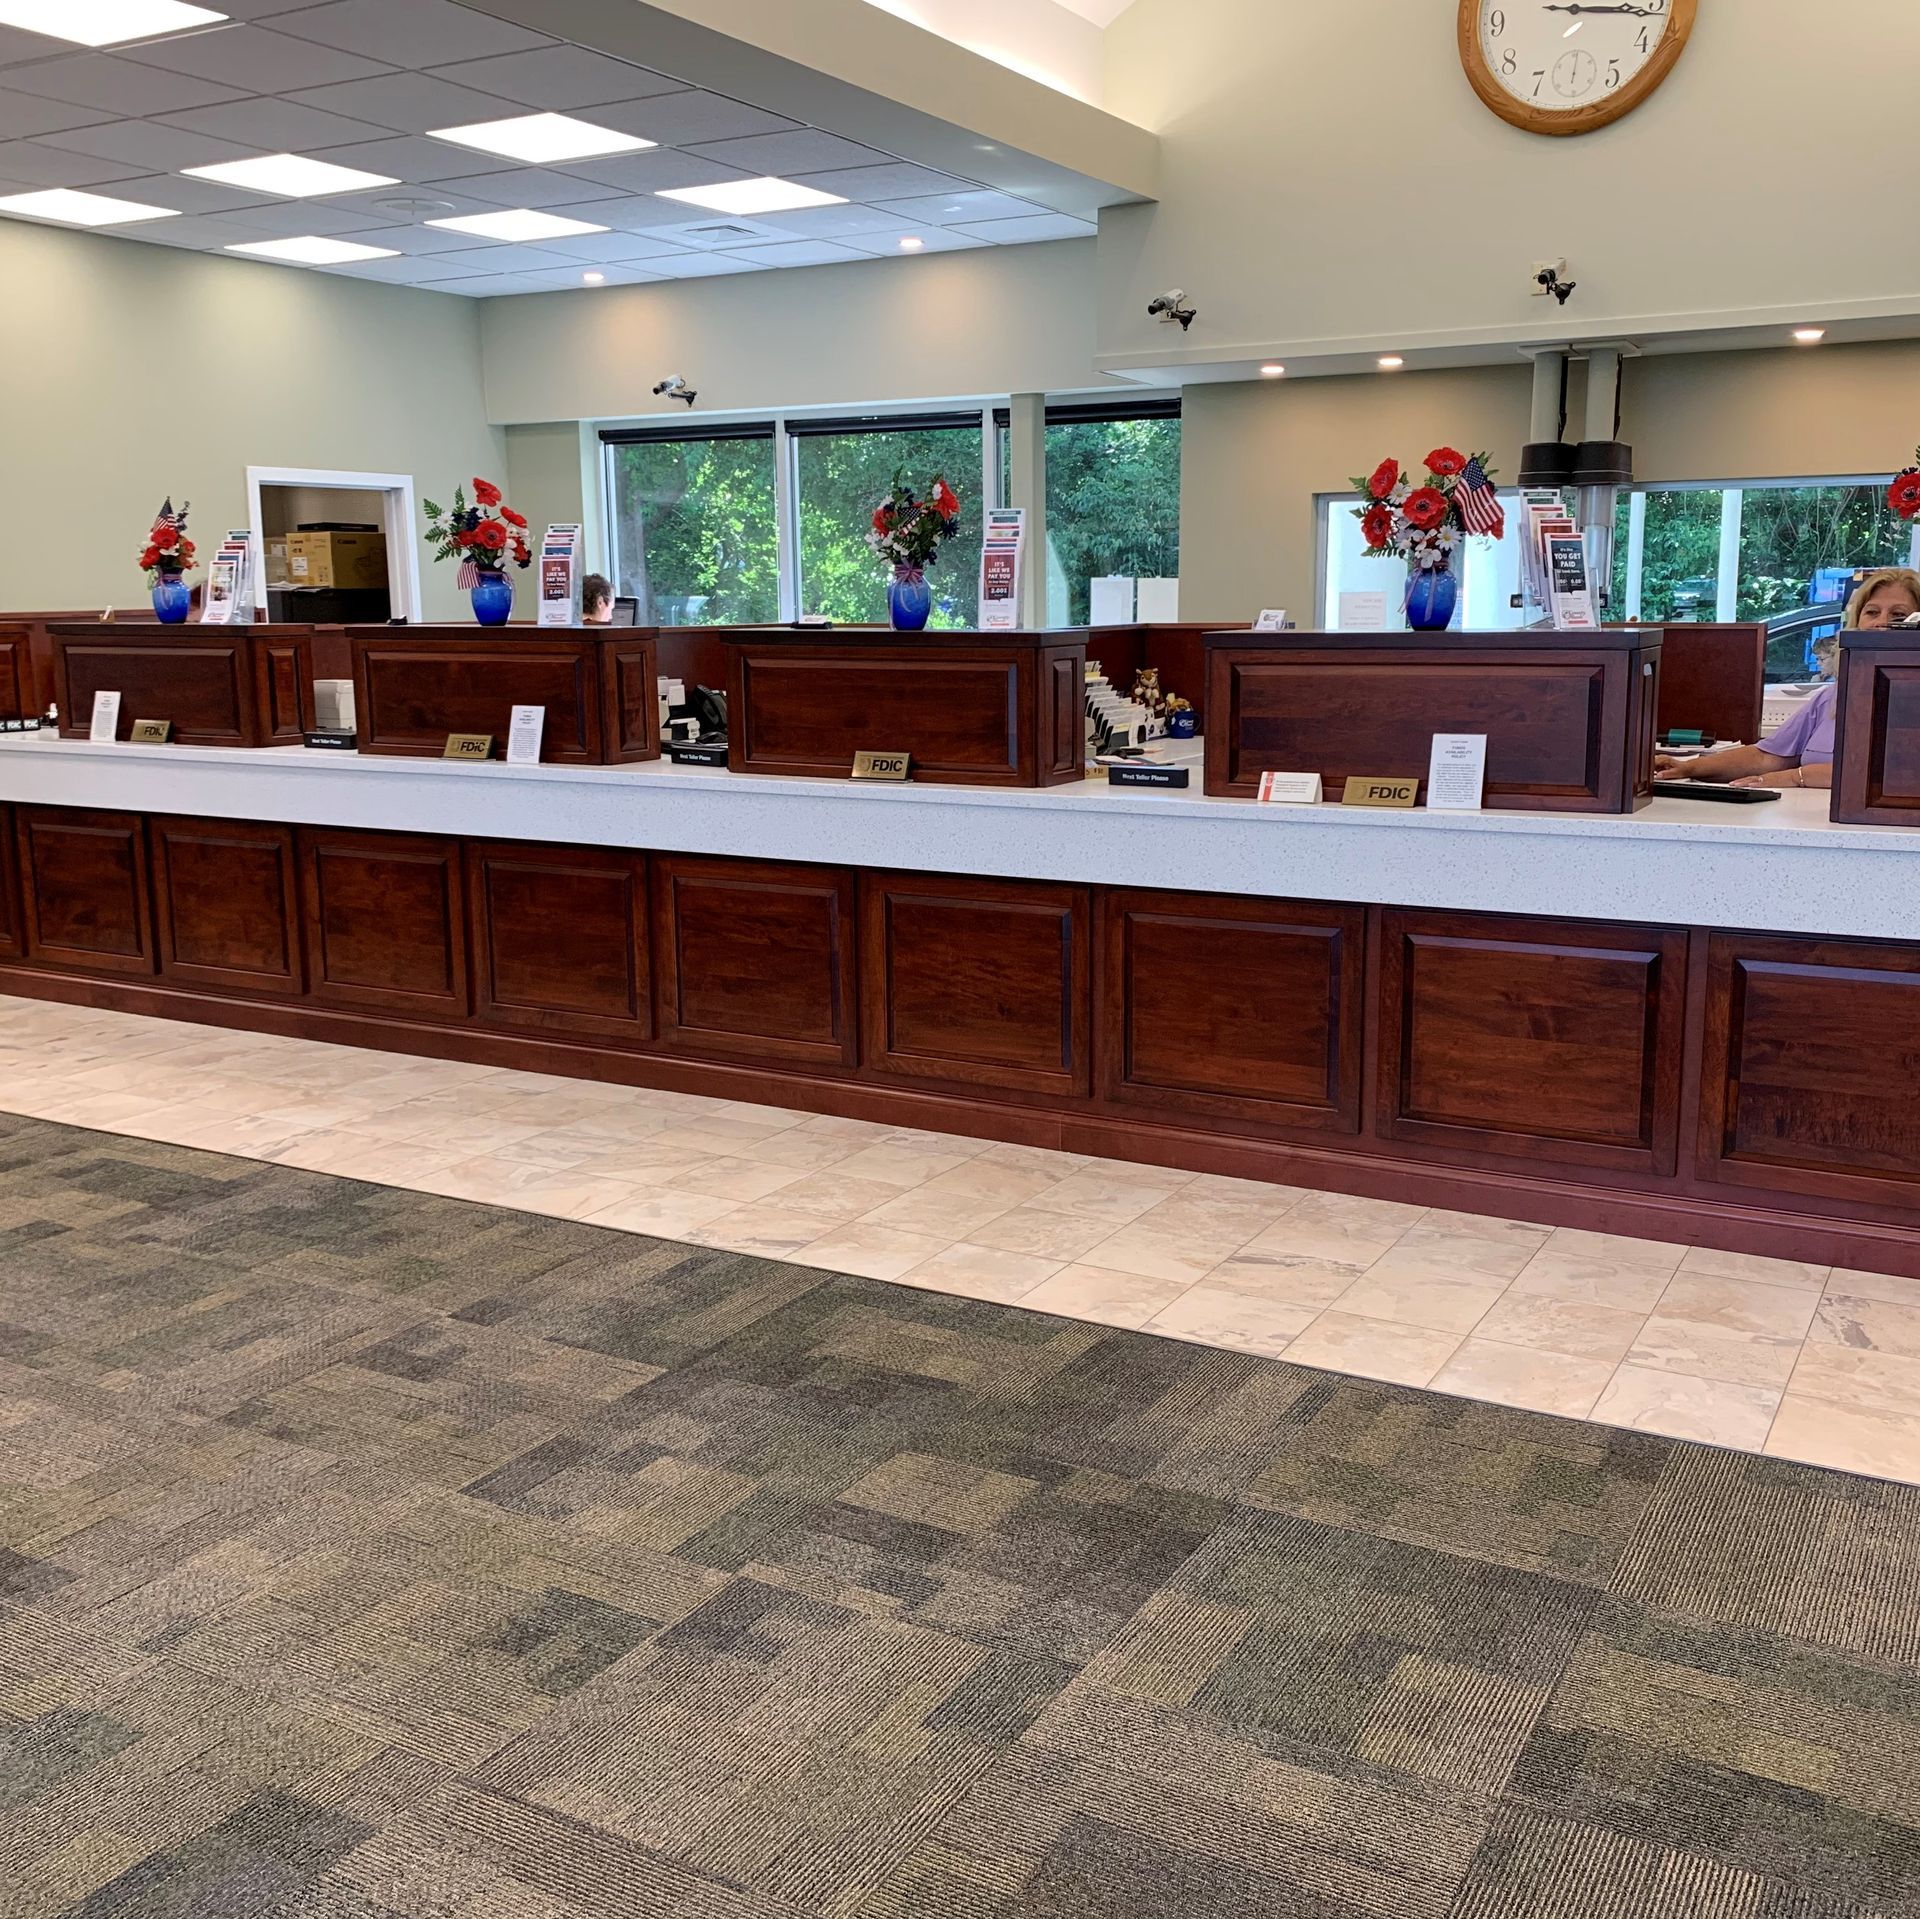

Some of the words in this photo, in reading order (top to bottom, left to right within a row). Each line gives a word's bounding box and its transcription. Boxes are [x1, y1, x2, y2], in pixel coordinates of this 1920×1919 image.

[1490, 10, 1505, 37] 9
[1633, 26, 1648, 53] 4
[1501, 48, 1517, 75] 8
[1604, 59, 1620, 88] 5
[1532, 70, 1546, 96] 7
[460, 741, 486, 752] FDIC
[871, 759, 903, 771] FDIC
[1151, 774, 1170, 782] Please
[1368, 786, 1411, 800] FDIC
